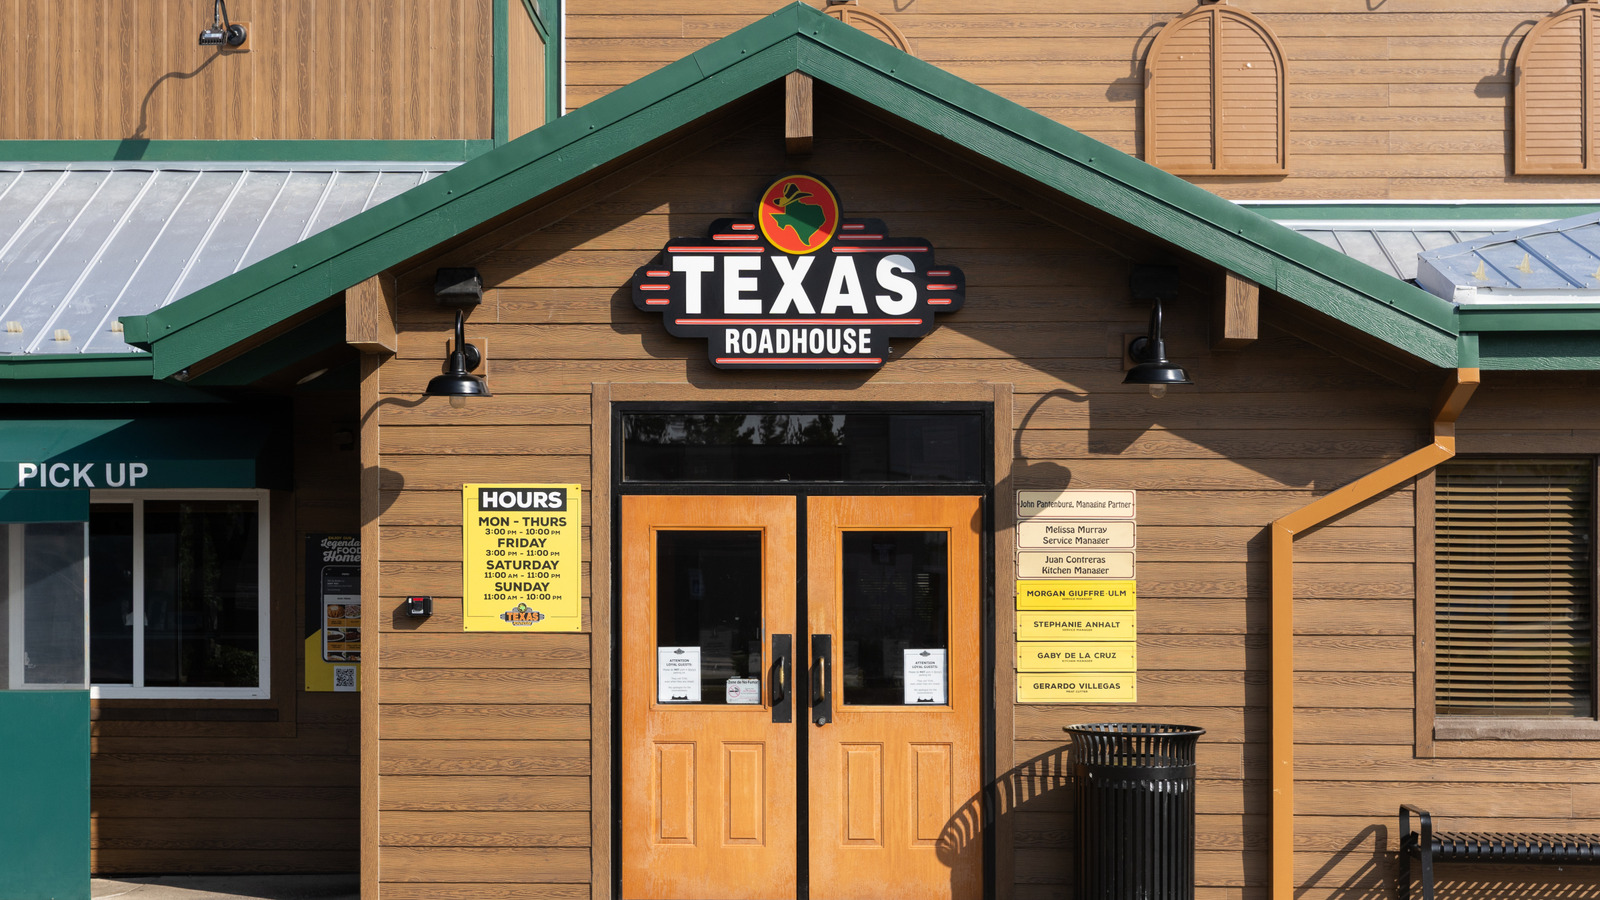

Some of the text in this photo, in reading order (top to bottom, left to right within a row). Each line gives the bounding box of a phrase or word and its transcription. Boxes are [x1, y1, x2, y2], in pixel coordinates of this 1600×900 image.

[672, 254, 918, 316] TEXAS
[725, 328, 871, 354] ROADHOUSE
[18, 462, 148, 488] PICK UP
[482, 491, 562, 509] HOURS
[1020, 500, 1131, 508] John Pantenburg, Managing Partner
[479, 517, 510, 526] MON
[522, 517, 567, 526] THURS
[1046, 526, 1107, 534] Melissa Murray
[498, 538, 547, 548] FRIDAY
[323, 550, 361, 562] Home
[486, 560, 559, 570] SATURDAY
[495, 582, 550, 592] SUNDAY
[506, 612, 539, 621] TEXAS
